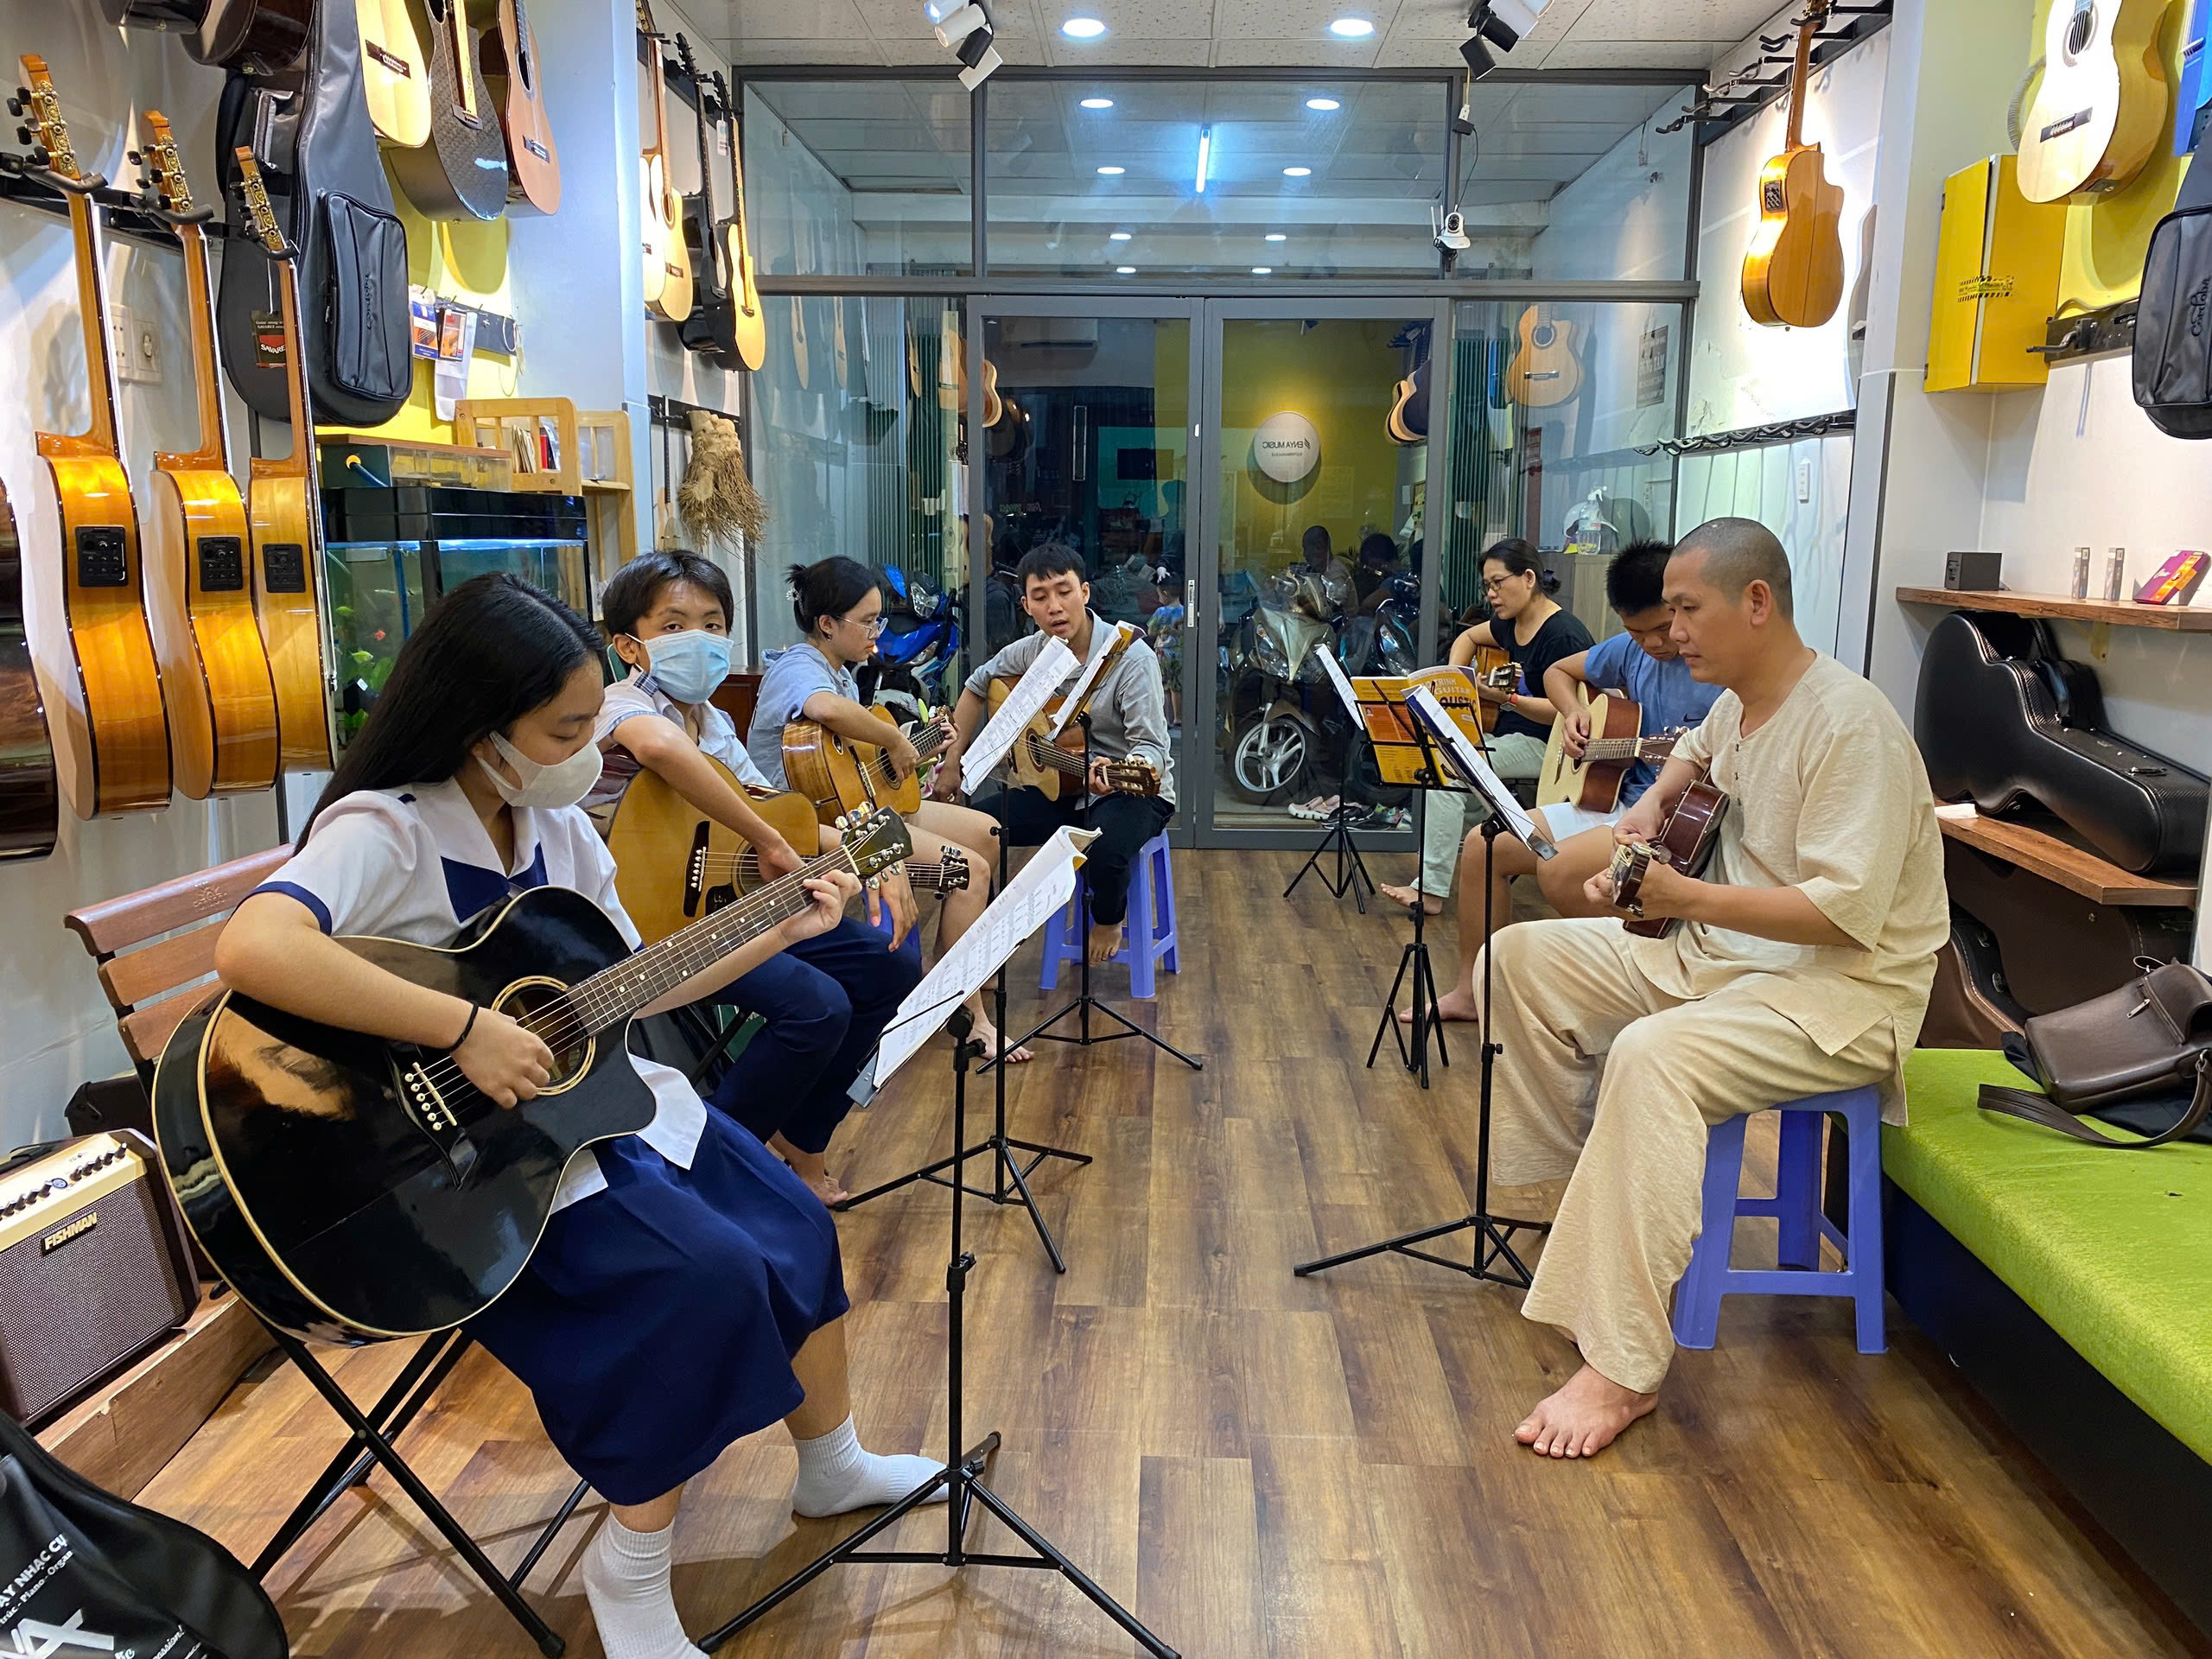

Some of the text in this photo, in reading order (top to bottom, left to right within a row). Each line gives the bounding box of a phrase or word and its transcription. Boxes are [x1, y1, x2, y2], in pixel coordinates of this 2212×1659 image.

[260, 343, 286, 354] SAVARE
[1440, 696, 1477, 713] OUSTIC
[44, 1211, 98, 1250] FISHMAN
[0, 1534, 68, 1608] ẠY NHẠC CỤ
[19, 1578, 46, 1603] Piano
[47, 1550, 73, 1576] Organ
